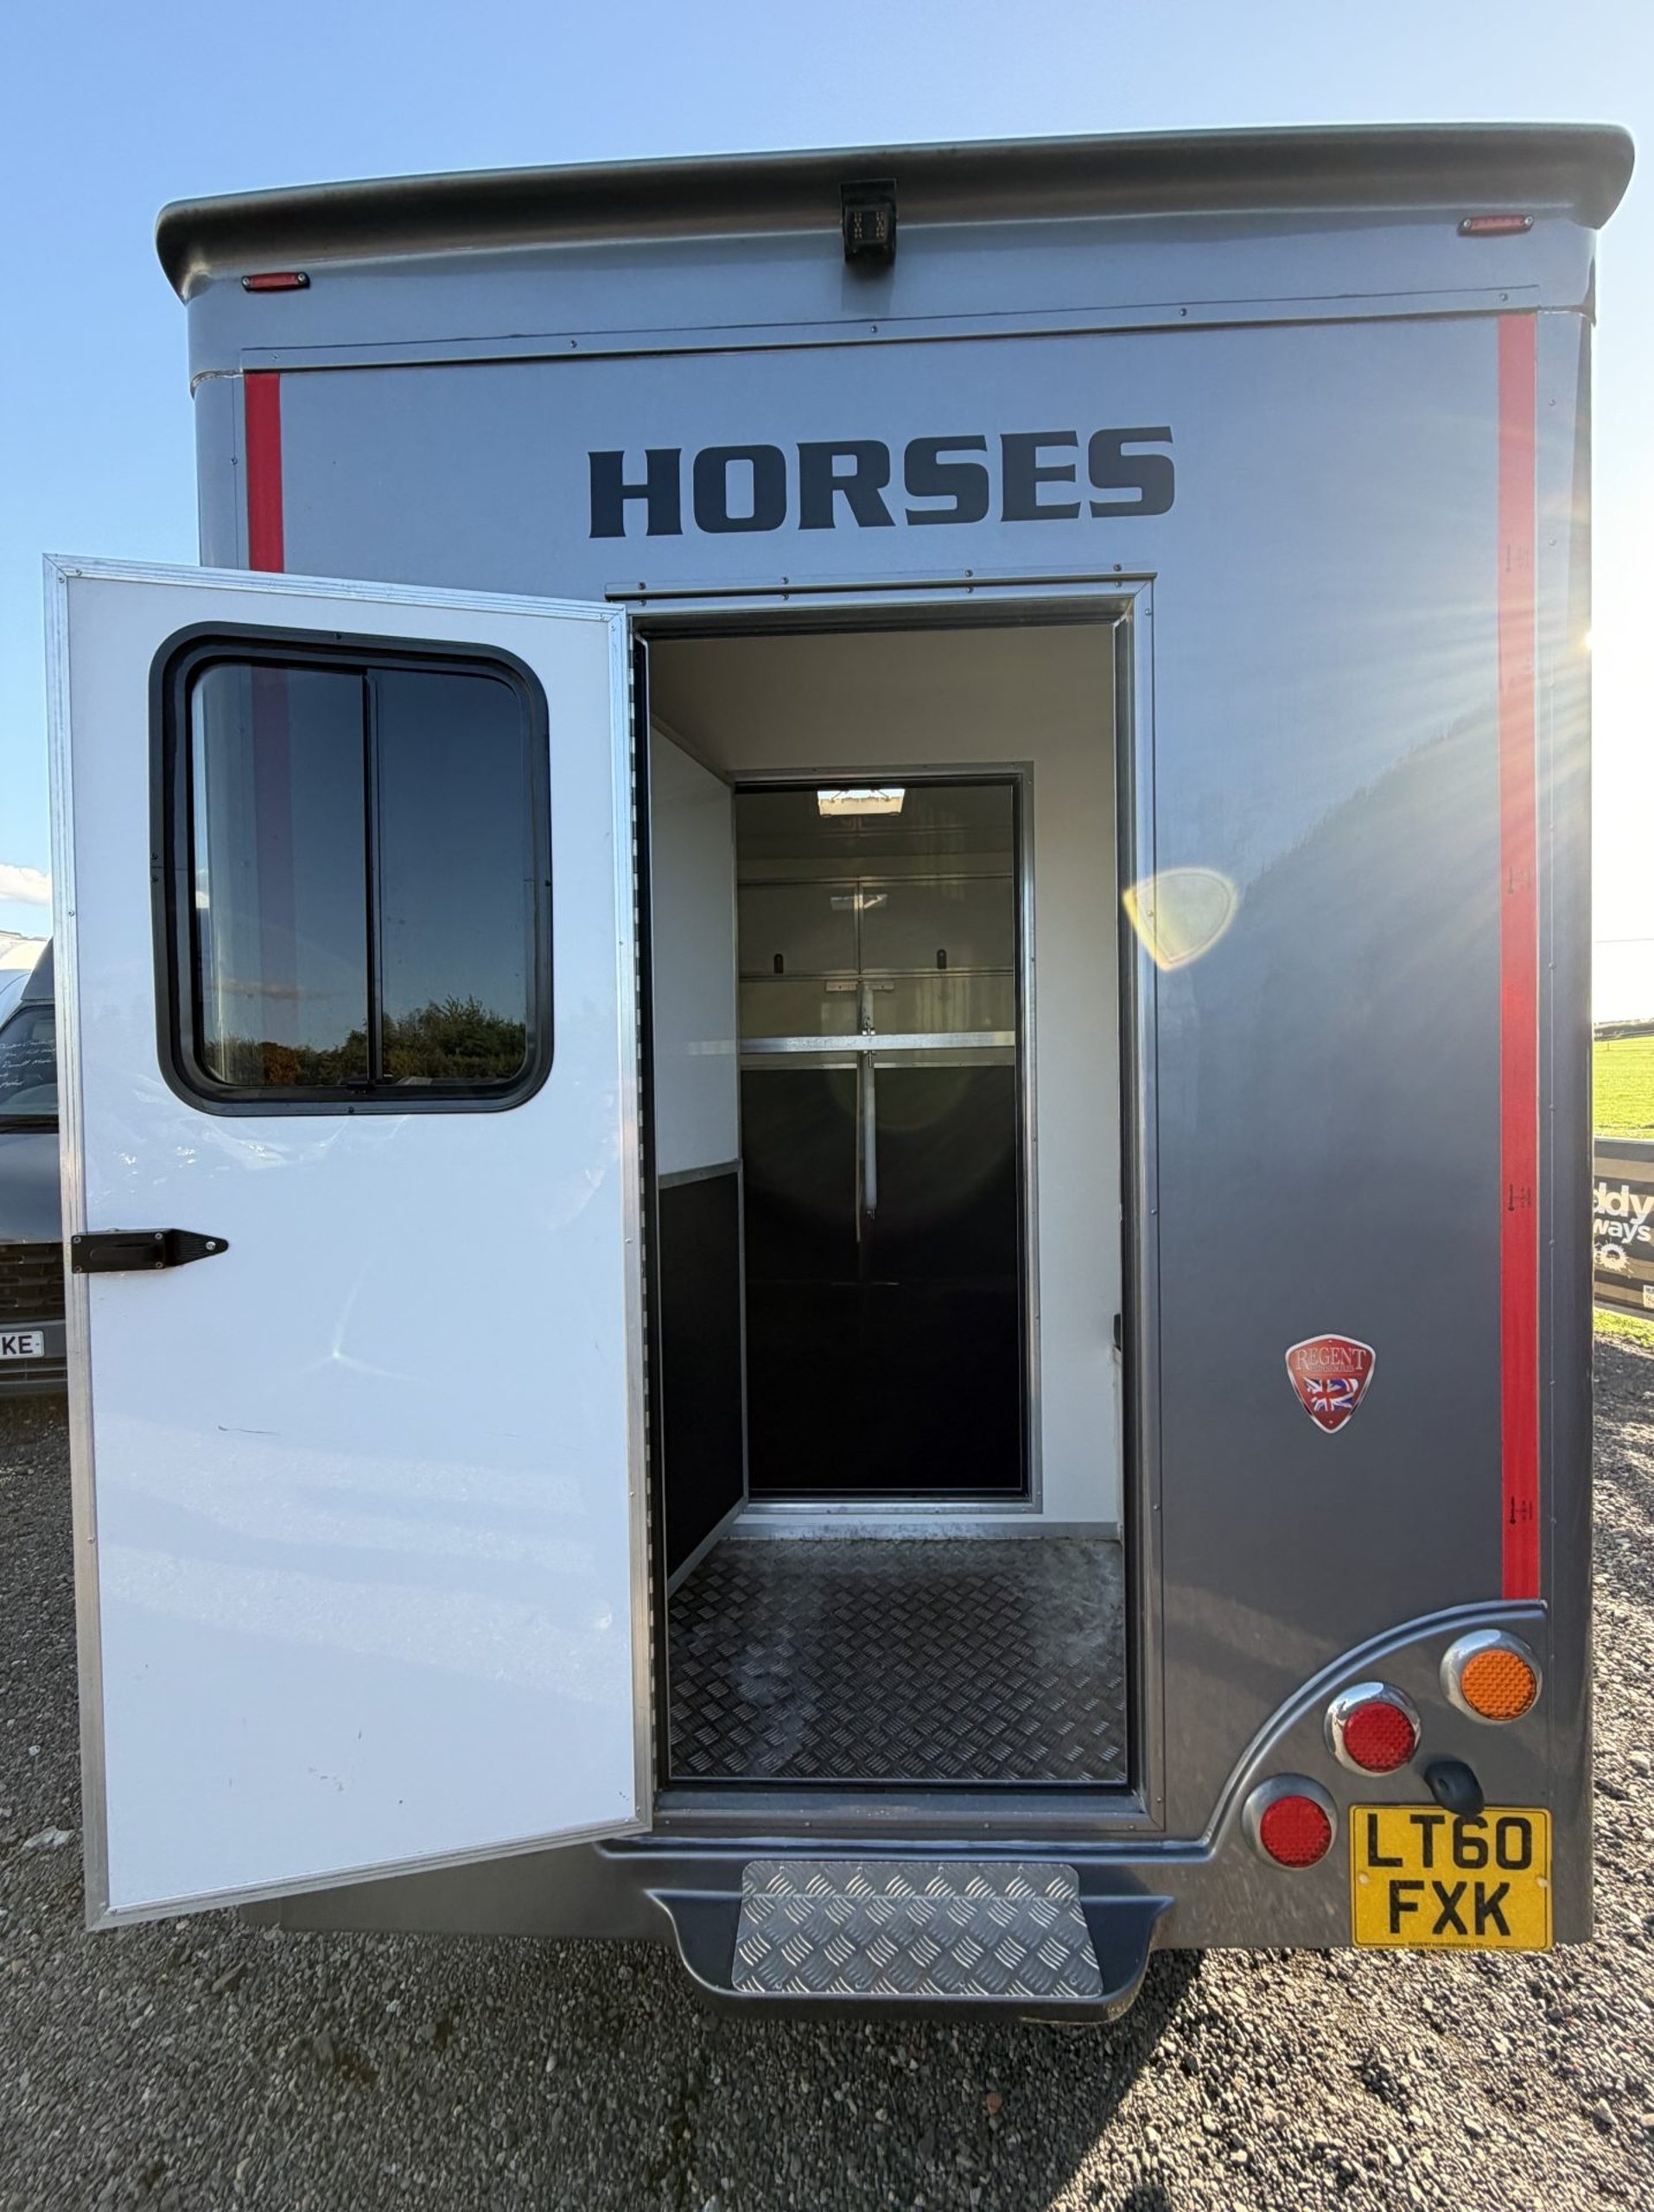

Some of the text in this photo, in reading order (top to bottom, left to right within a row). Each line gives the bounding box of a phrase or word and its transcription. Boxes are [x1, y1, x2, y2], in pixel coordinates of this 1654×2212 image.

[588, 426, 1175, 538] HORSES
[2, 1335, 34, 1355] KE
[1295, 1346, 1366, 1370] REGENT
[1367, 1813, 1532, 1871] LT60
[1390, 1879, 1511, 1936] FXK
